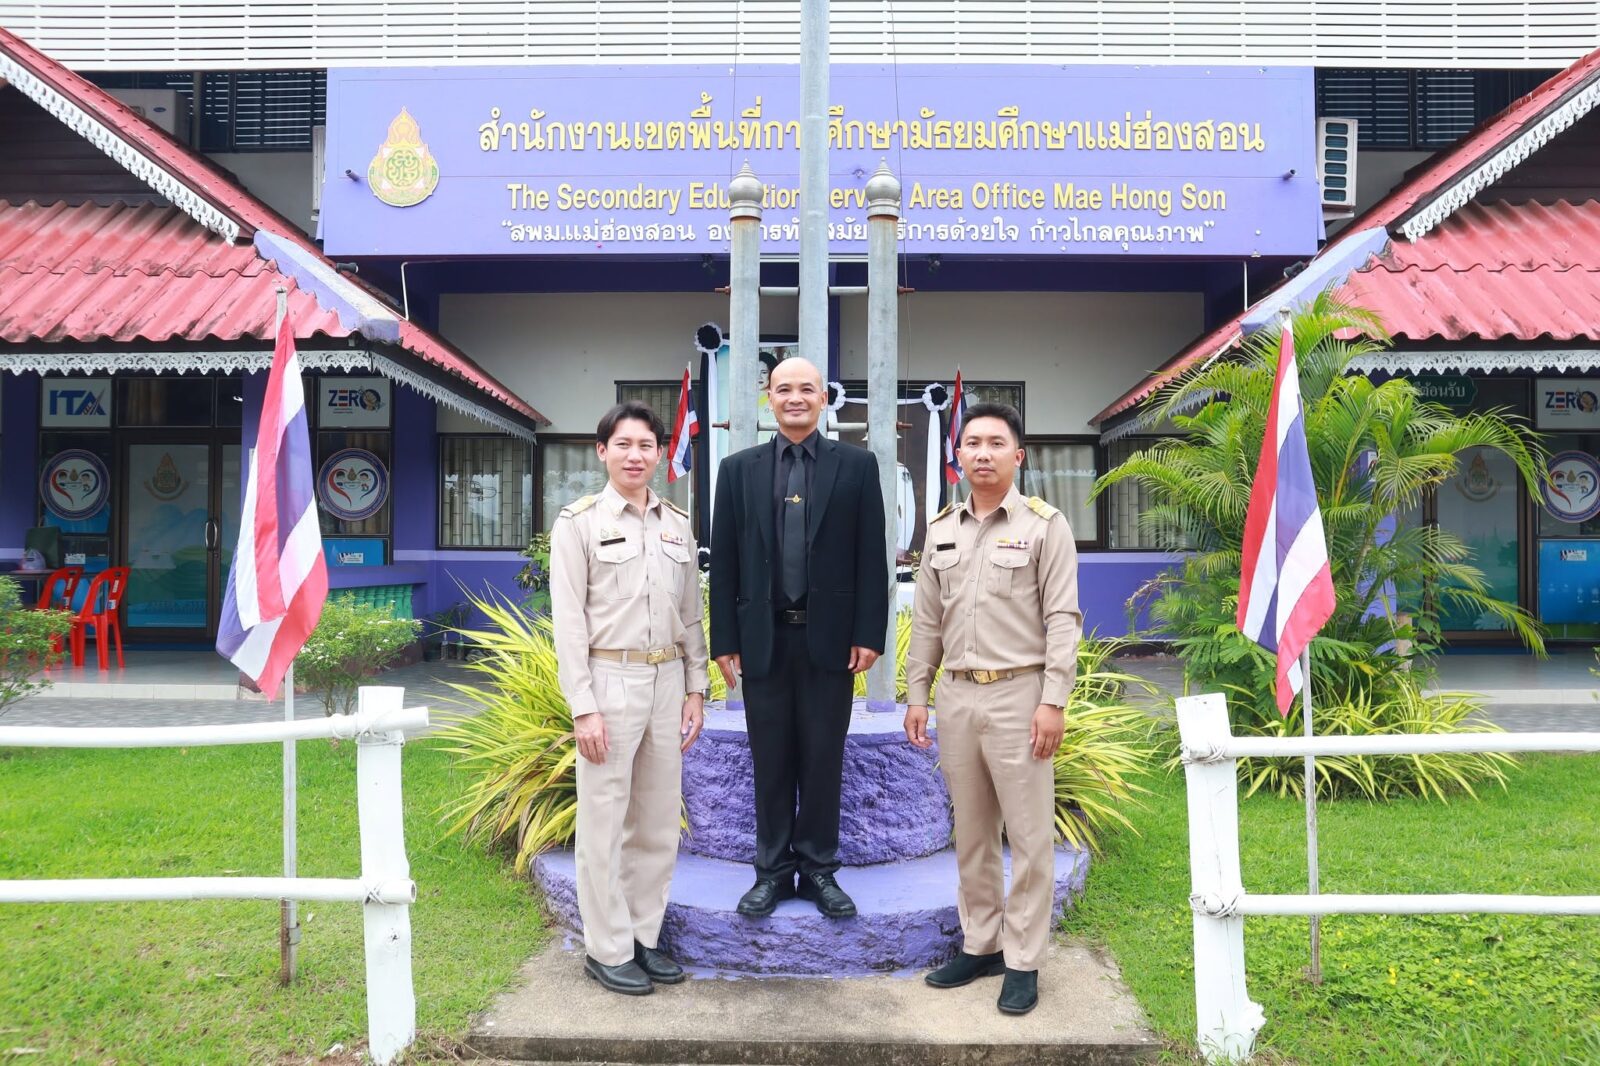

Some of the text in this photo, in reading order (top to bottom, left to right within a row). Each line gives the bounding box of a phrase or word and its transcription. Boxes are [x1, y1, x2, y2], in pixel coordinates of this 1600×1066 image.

[478, 91, 1266, 152] สำนักงานเขตพื้นที่กาศึกษามัธยมศึกษาแม่ฮ่องสอน
[507, 183, 550, 210] The
[556, 182, 681, 215] Secondary
[690, 182, 800, 210] Edution
[909, 182, 963, 210] Area
[971, 182, 1045, 210] Office
[1054, 182, 1103, 210] Mae
[1111, 182, 1172, 217] Hong
[1181, 182, 1227, 210] Son
[896, 215, 1020, 243] ริการด้วยใจ
[49, 389, 107, 416] ITA
[328, 388, 381, 412] ZERO
